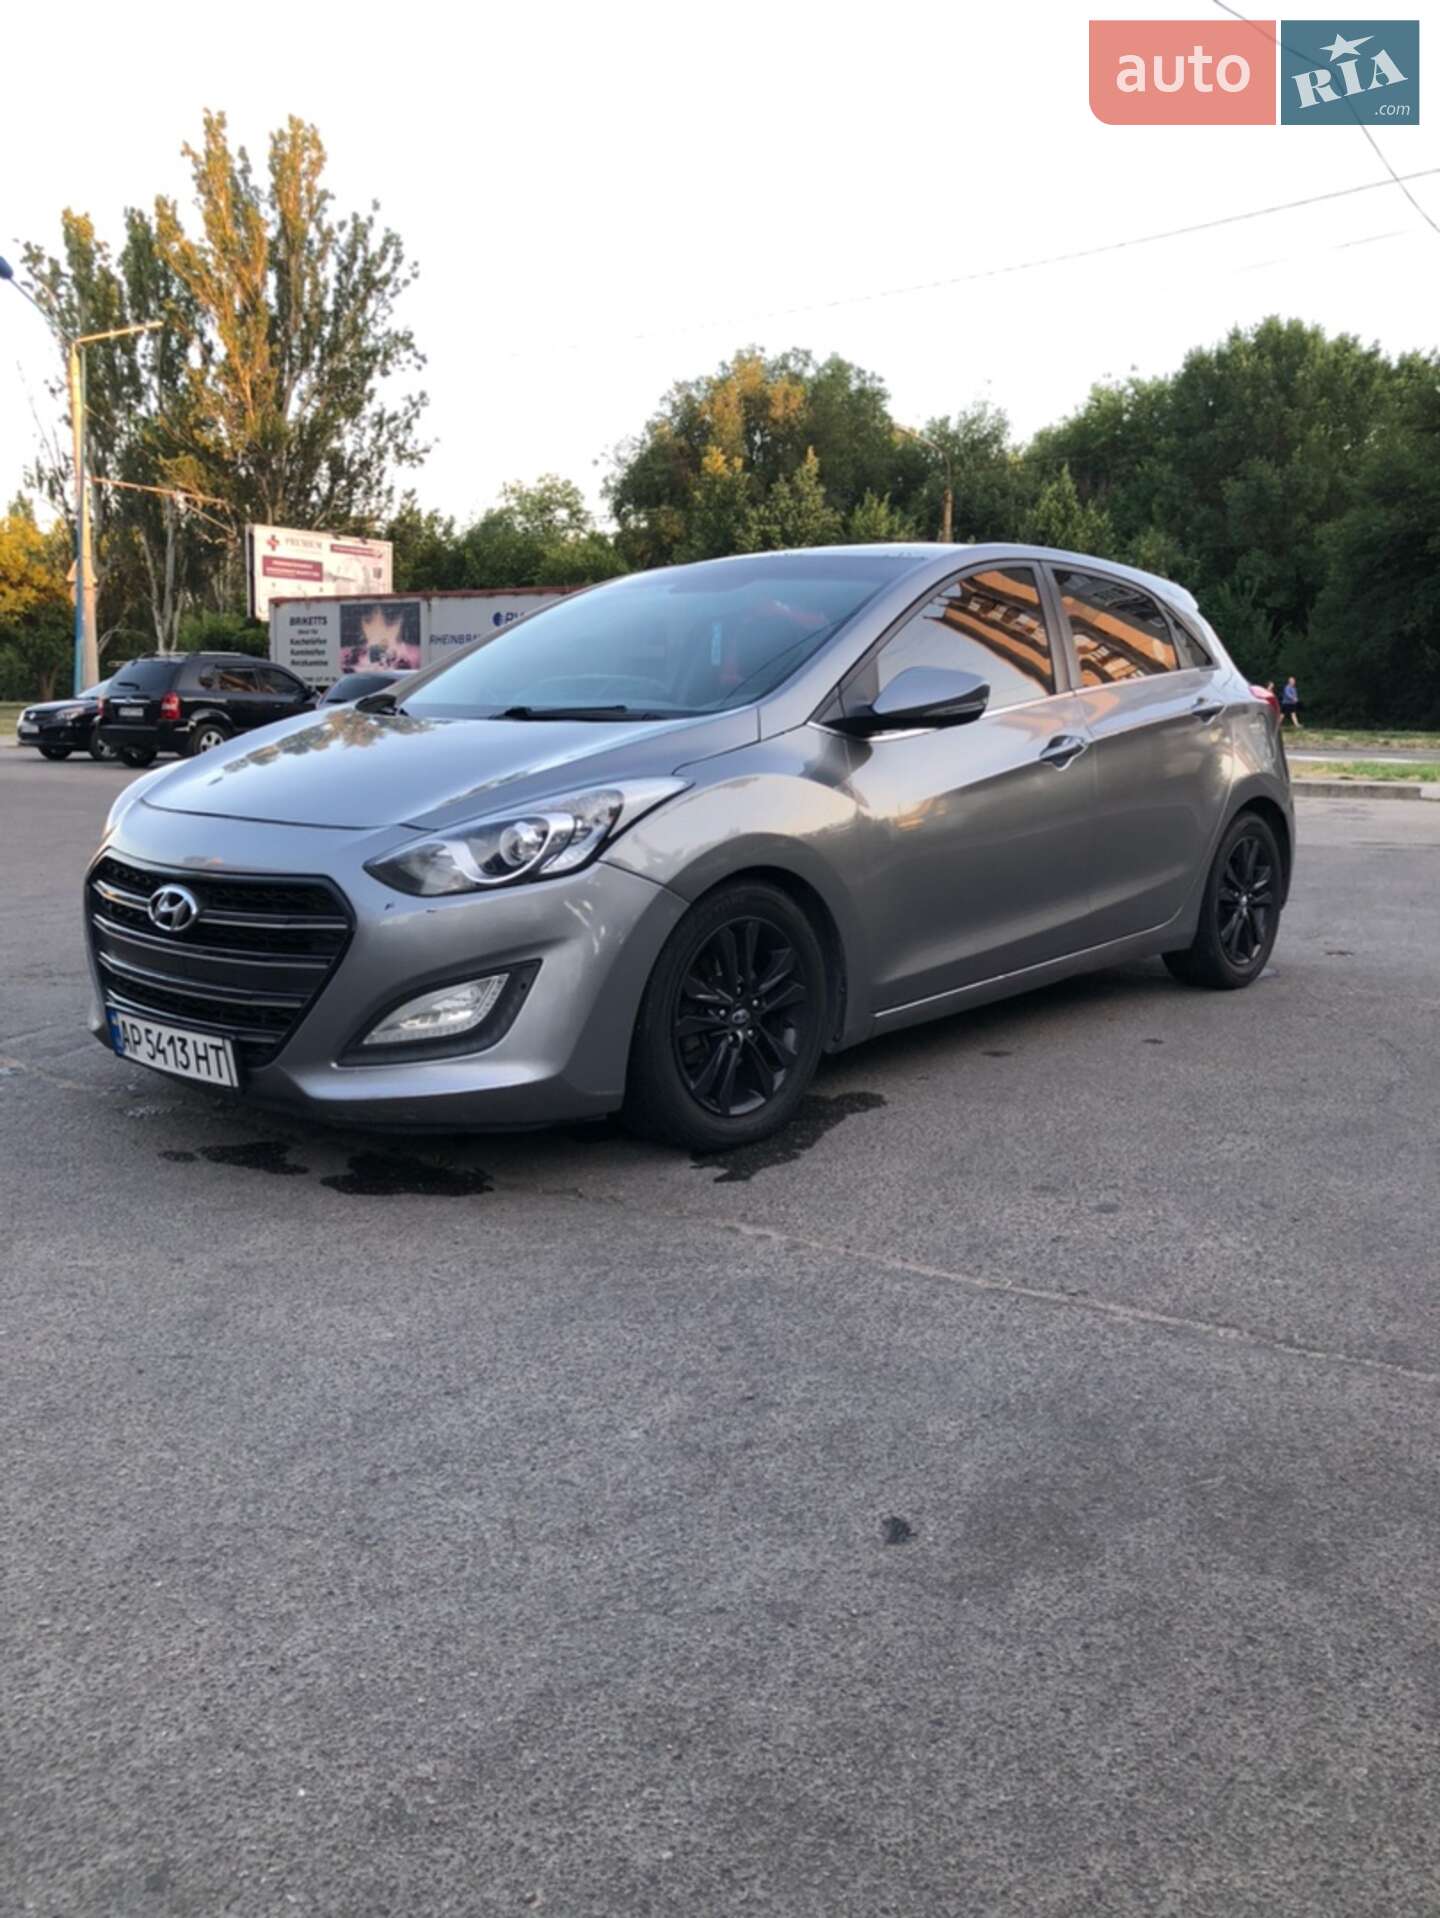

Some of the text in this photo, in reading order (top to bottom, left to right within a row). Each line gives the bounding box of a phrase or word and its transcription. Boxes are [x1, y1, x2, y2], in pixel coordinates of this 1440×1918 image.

[289, 615, 328, 626] BRIKETTS
[430, 633, 481, 645] RHEINBRA
[122, 1020, 224, 1079] AP 5413 HT
